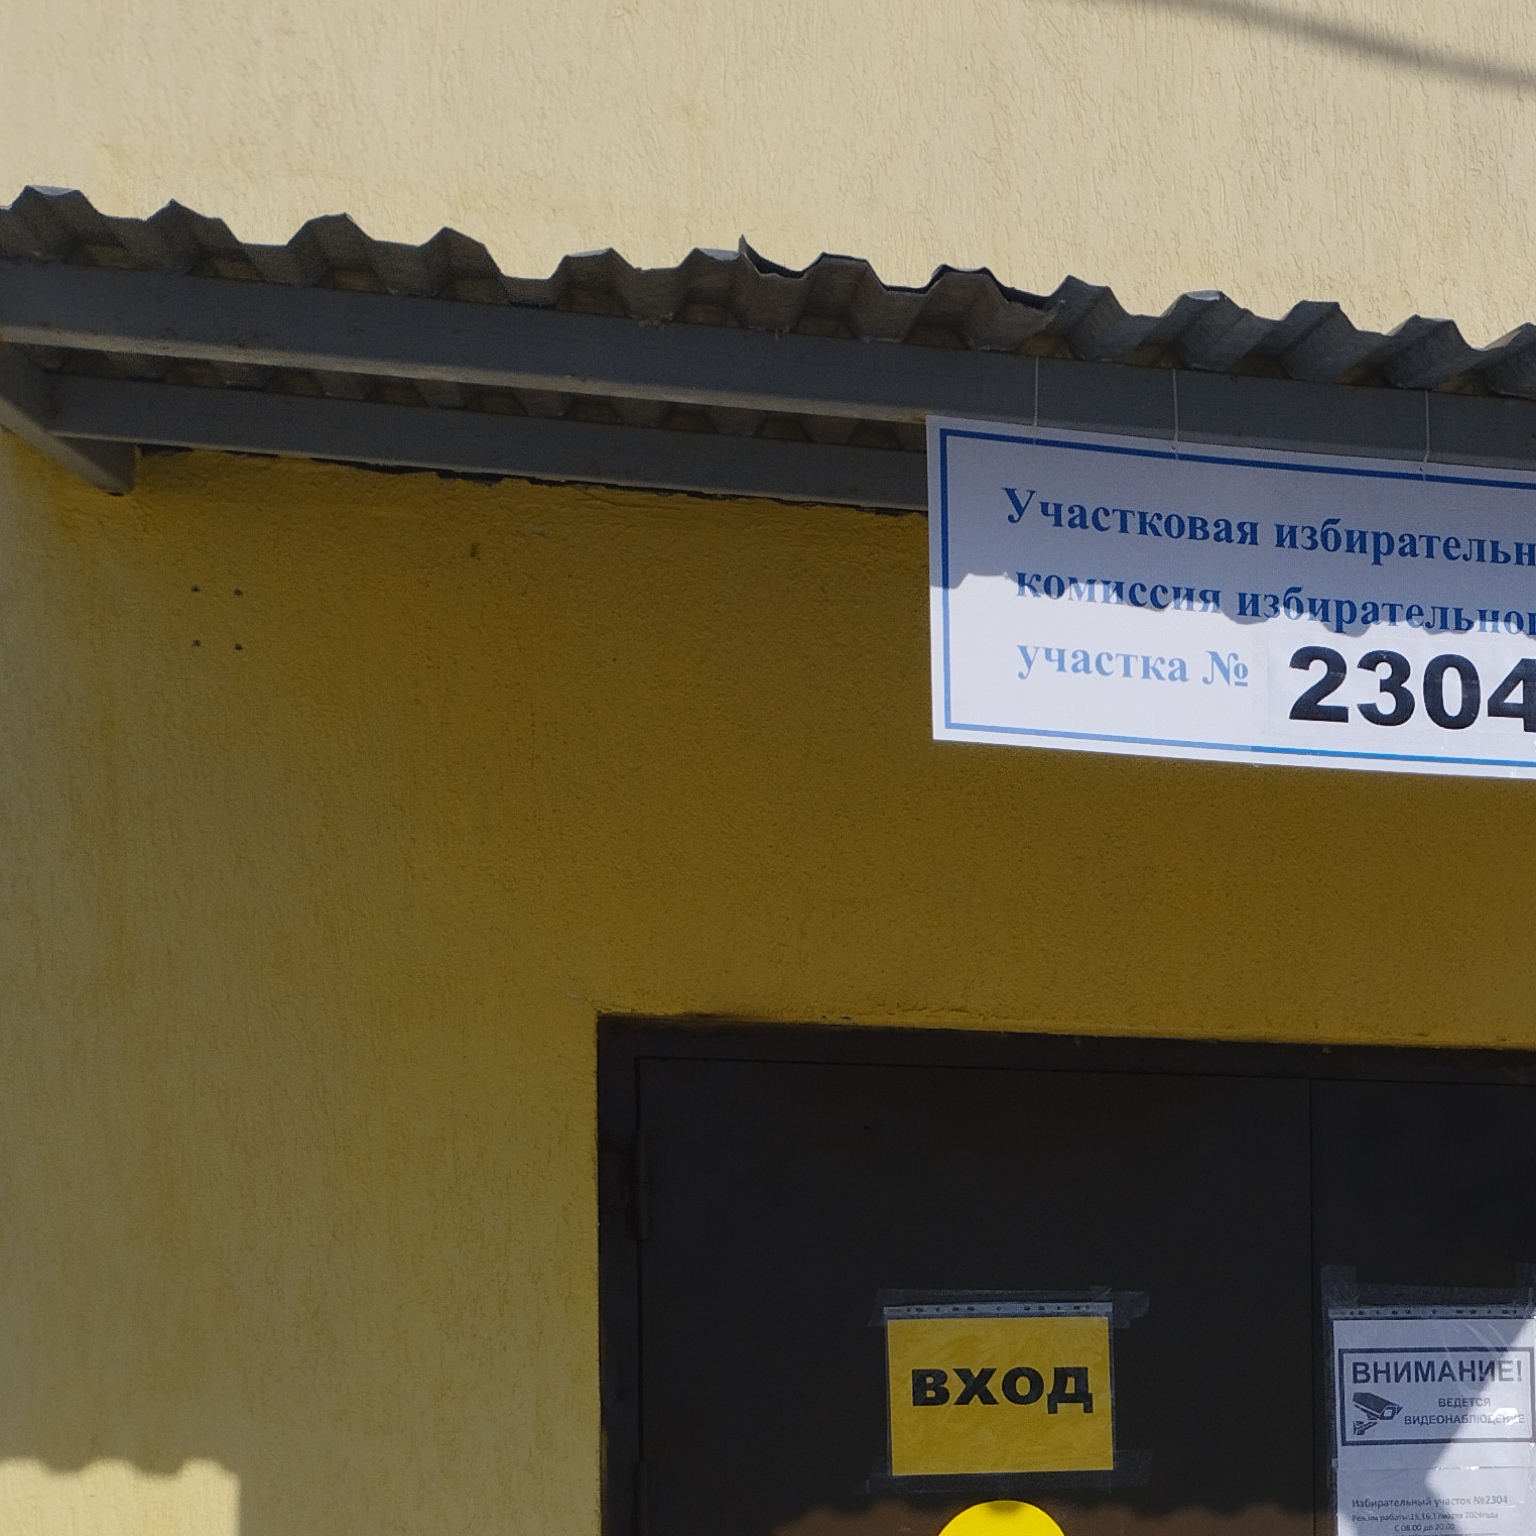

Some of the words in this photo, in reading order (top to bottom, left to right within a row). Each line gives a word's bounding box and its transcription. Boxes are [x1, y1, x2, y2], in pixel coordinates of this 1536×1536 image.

[1002, 486, 1259, 546] Участковая
[1016, 569, 1222, 614] комиссия
[1016, 642, 1188, 683] участка
[1352, 1359, 1522, 1385] ВНИМАНИЕ!
[911, 1366, 1094, 1415] ВХОД
[1438, 1397, 1491, 1410] ВЕДЕТСЯ
[1404, 1413, 1526, 1427] ВИДЕОНАБЛЮДЕНЕ
[1351, 1496, 1432, 1510] Избирательный
[1434, 1497, 1471, 1508] участок
